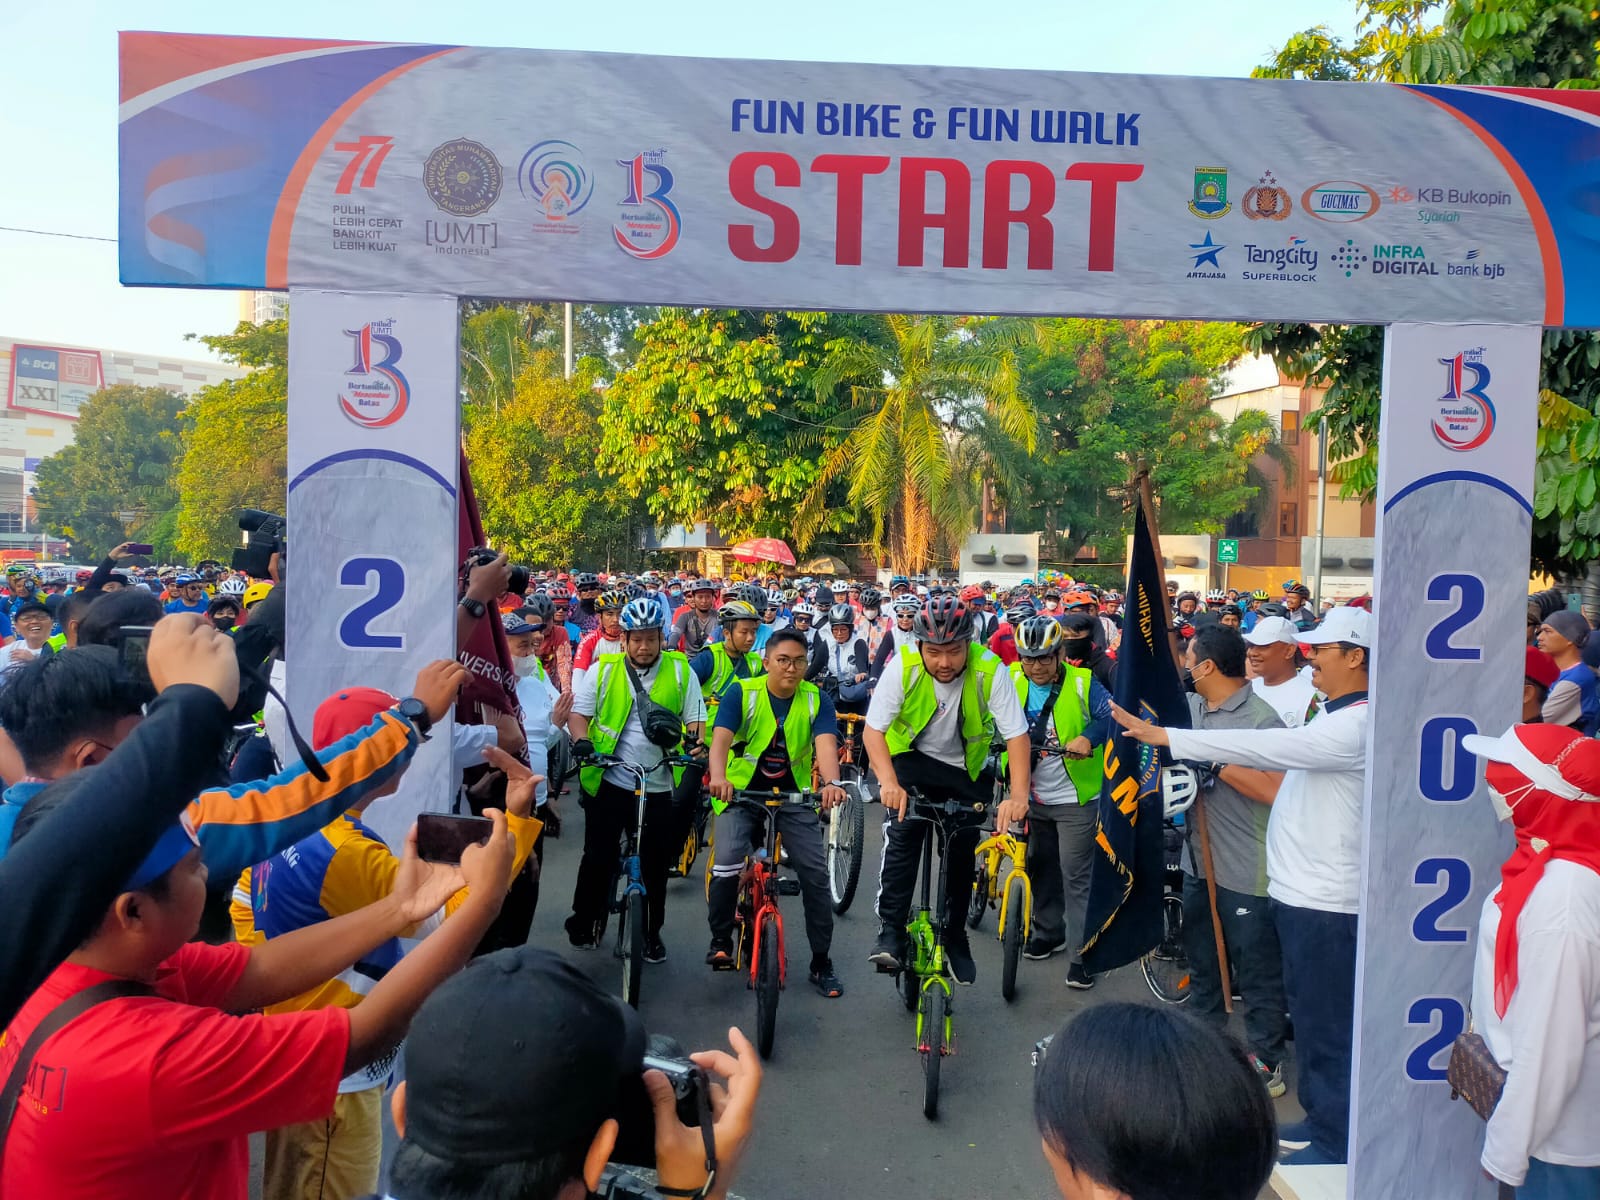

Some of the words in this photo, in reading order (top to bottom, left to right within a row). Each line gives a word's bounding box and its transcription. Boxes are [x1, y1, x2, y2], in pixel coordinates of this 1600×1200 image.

[731, 98, 804, 135] FUN
[816, 102, 901, 139] BIKE
[912, 107, 937, 139] &
[947, 107, 1019, 142] FUN
[1030, 109, 1141, 146] WALK
[334, 135, 395, 195] 77
[440, 198, 487, 212] TANGERANG
[1320, 193, 1360, 210] GUCIMAS
[1418, 188, 1443, 203] KB
[1448, 188, 1512, 207] Bukopin
[333, 204, 366, 215] PULIH
[728, 151, 1144, 272] START
[1417, 209, 1461, 225] Syariah
[333, 217, 366, 227] LEBIH
[368, 218, 404, 229] CEPAT
[333, 228, 382, 240] BANGKIT
[333, 241, 366, 251] LEBIH
[368, 242, 398, 253] KUAT
[1373, 244, 1425, 259] INFRA
[1186, 271, 1226, 280] ARTAJASA
[1372, 260, 1439, 276] DIGITAL
[1447, 262, 1479, 276] bank
[1483, 263, 1506, 280] bjb
[1242, 271, 1317, 282] SUPERBLOCK
[33, 360, 57, 370] BCA
[18, 384, 56, 402] XXI
